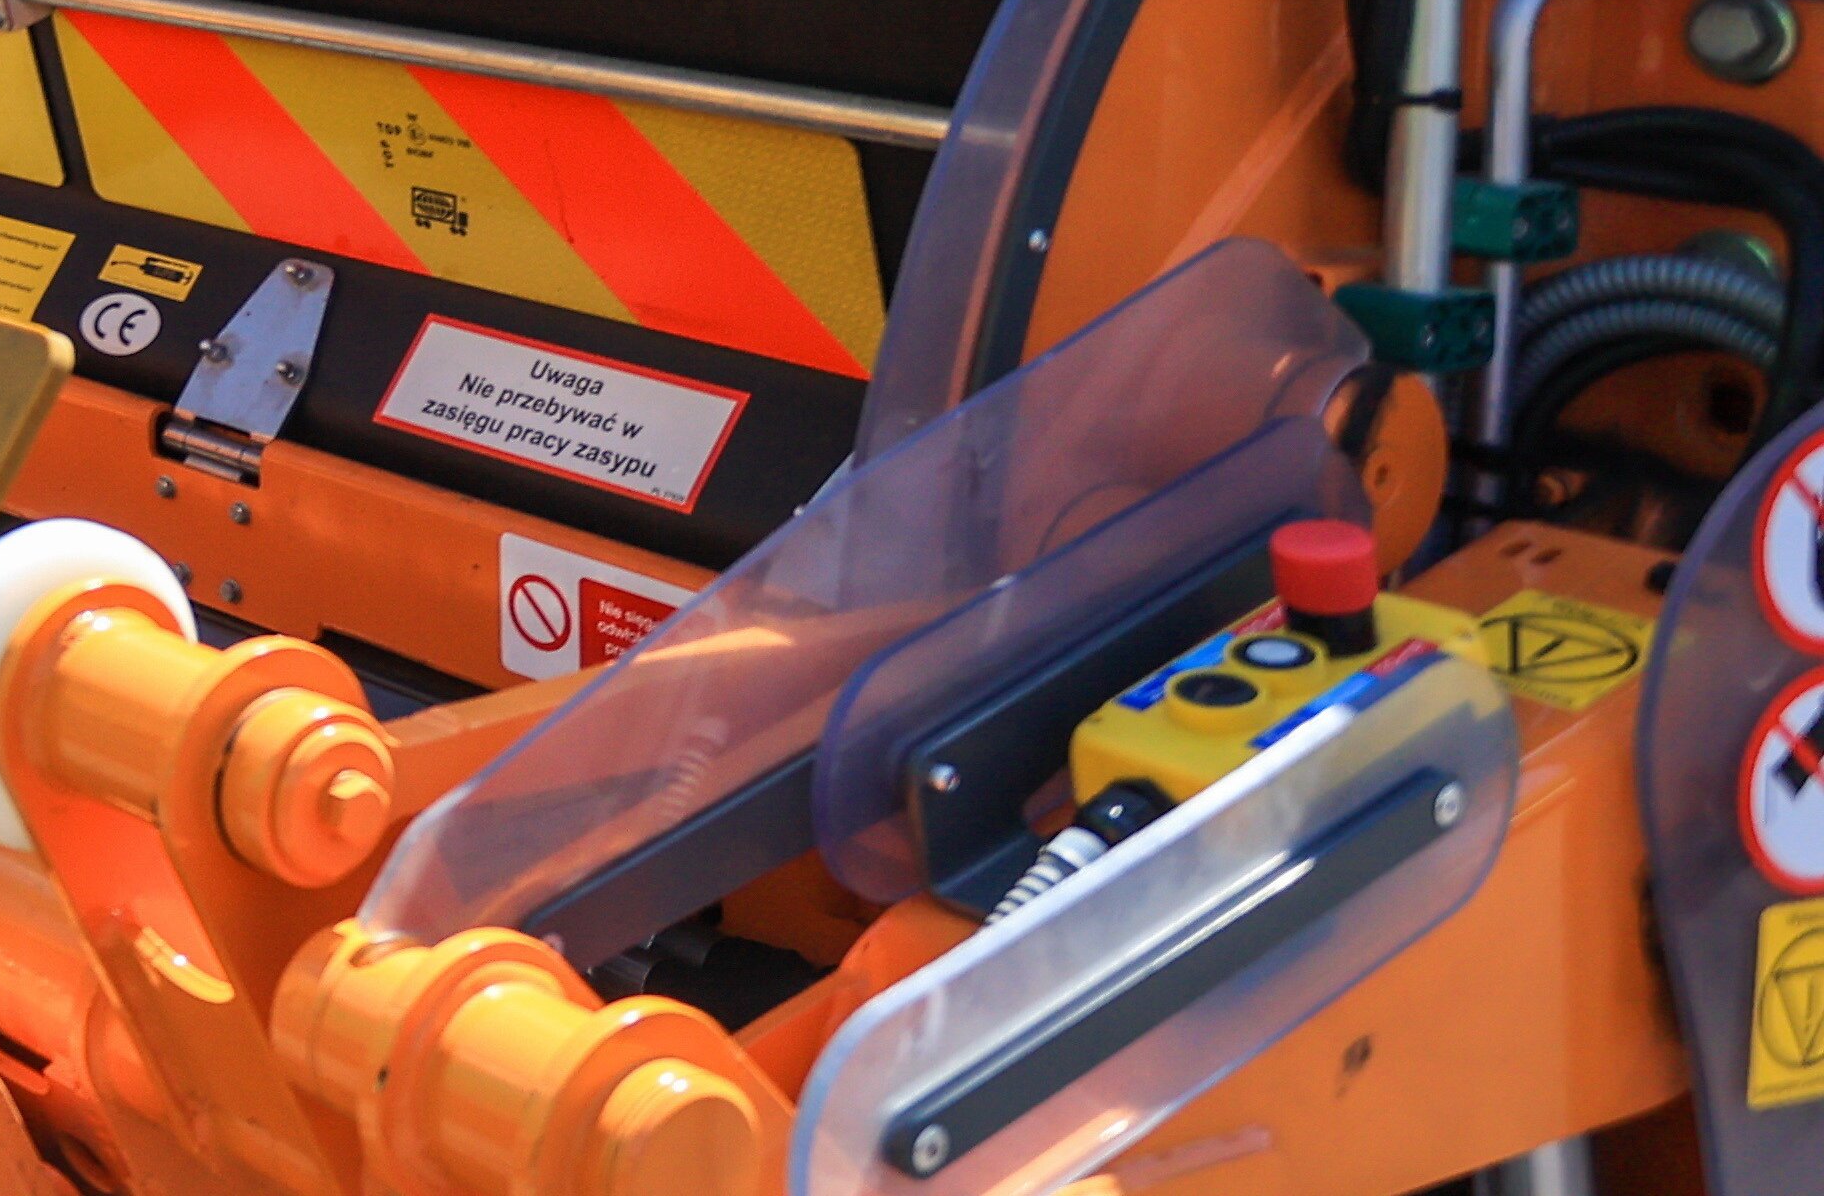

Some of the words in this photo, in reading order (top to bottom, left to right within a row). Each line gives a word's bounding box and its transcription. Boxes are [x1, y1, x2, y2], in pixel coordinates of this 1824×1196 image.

[94, 302, 148, 346] CE
[529, 359, 605, 396] Uwaga
[458, 373, 495, 399] Nie
[495, 387, 619, 433] przebywać
[621, 420, 644, 439] w
[421, 398, 505, 435] zasięgu
[504, 422, 571, 457] pracy
[572, 442, 657, 478] zasypu
[598, 599, 623, 620] Nie
